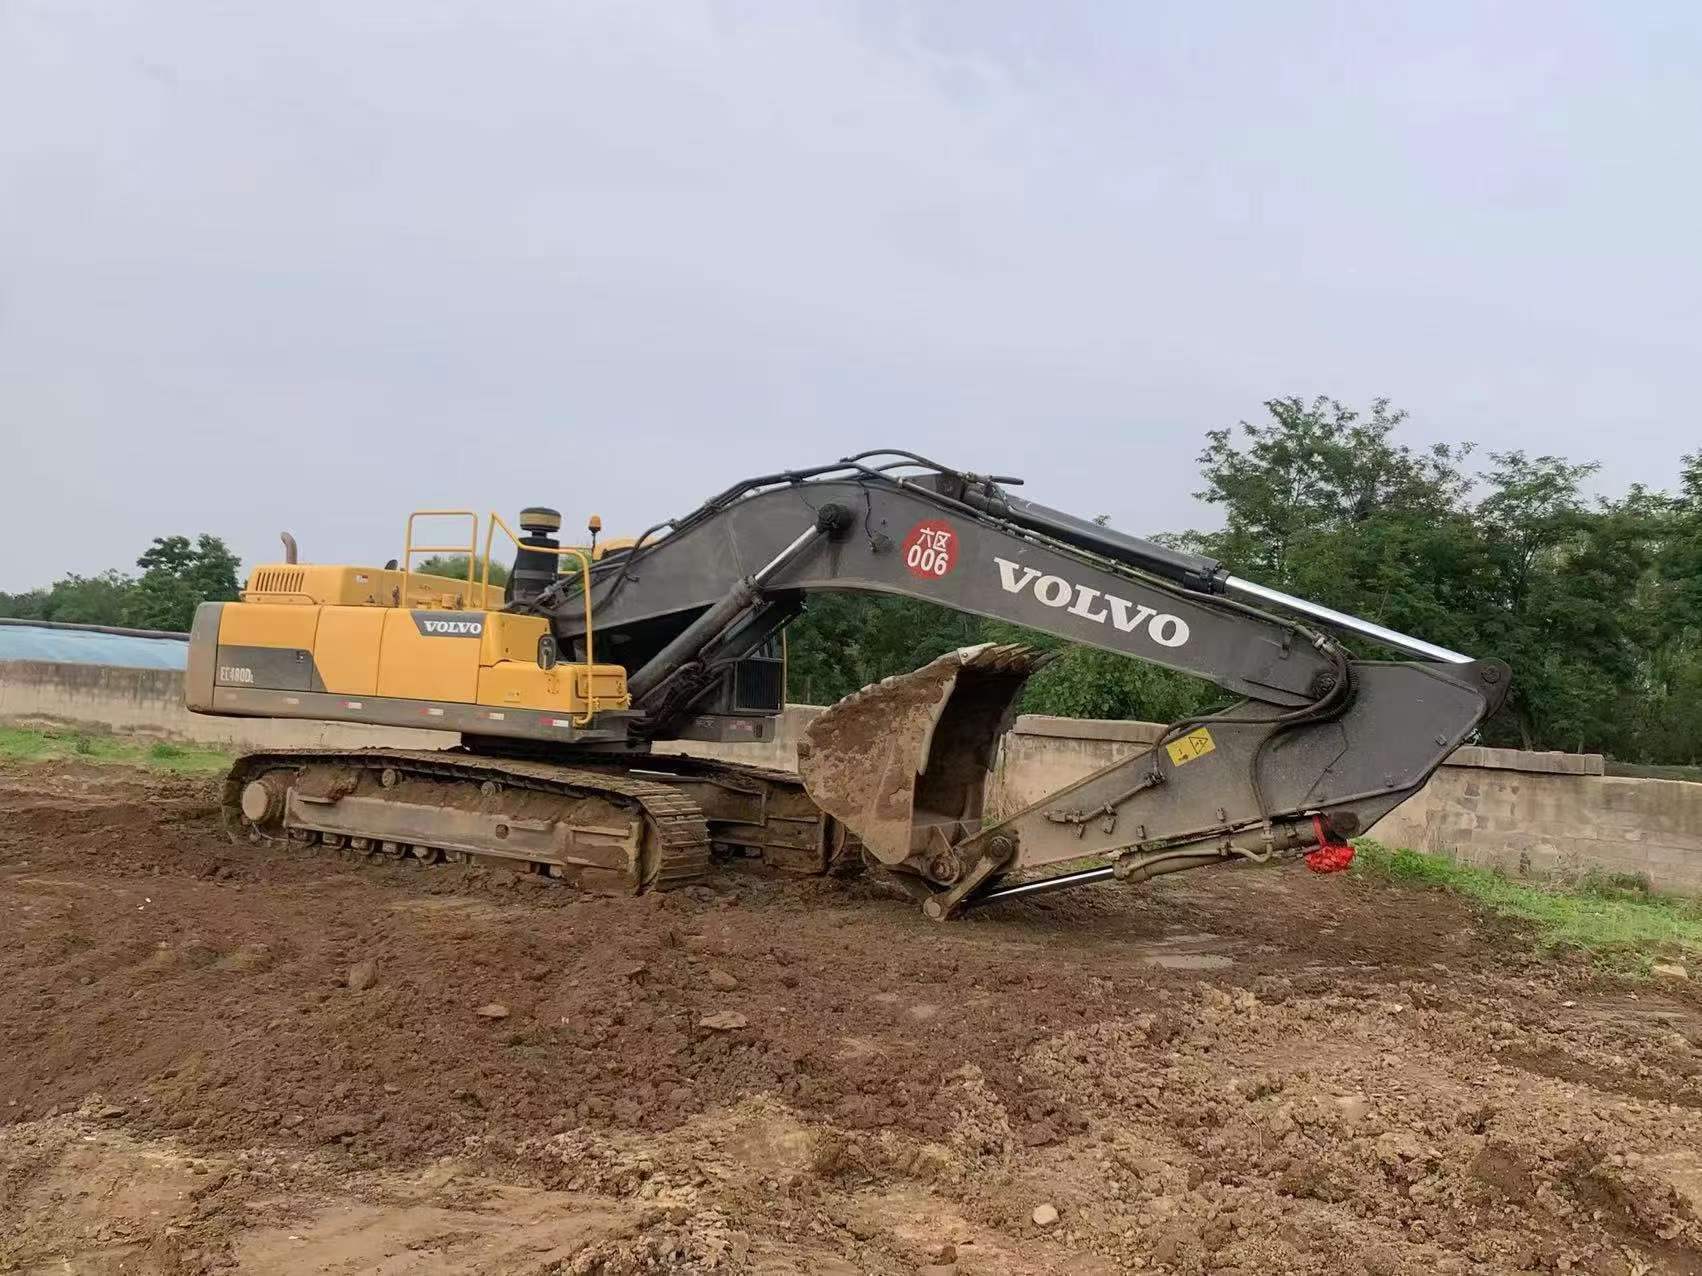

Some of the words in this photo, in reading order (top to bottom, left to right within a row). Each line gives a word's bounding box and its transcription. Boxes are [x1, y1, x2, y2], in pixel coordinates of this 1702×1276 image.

[916, 527, 951, 552] 六区
[907, 544, 949, 576] 006
[993, 556, 1190, 647] VOLVO
[423, 620, 482, 634] VOLVO
